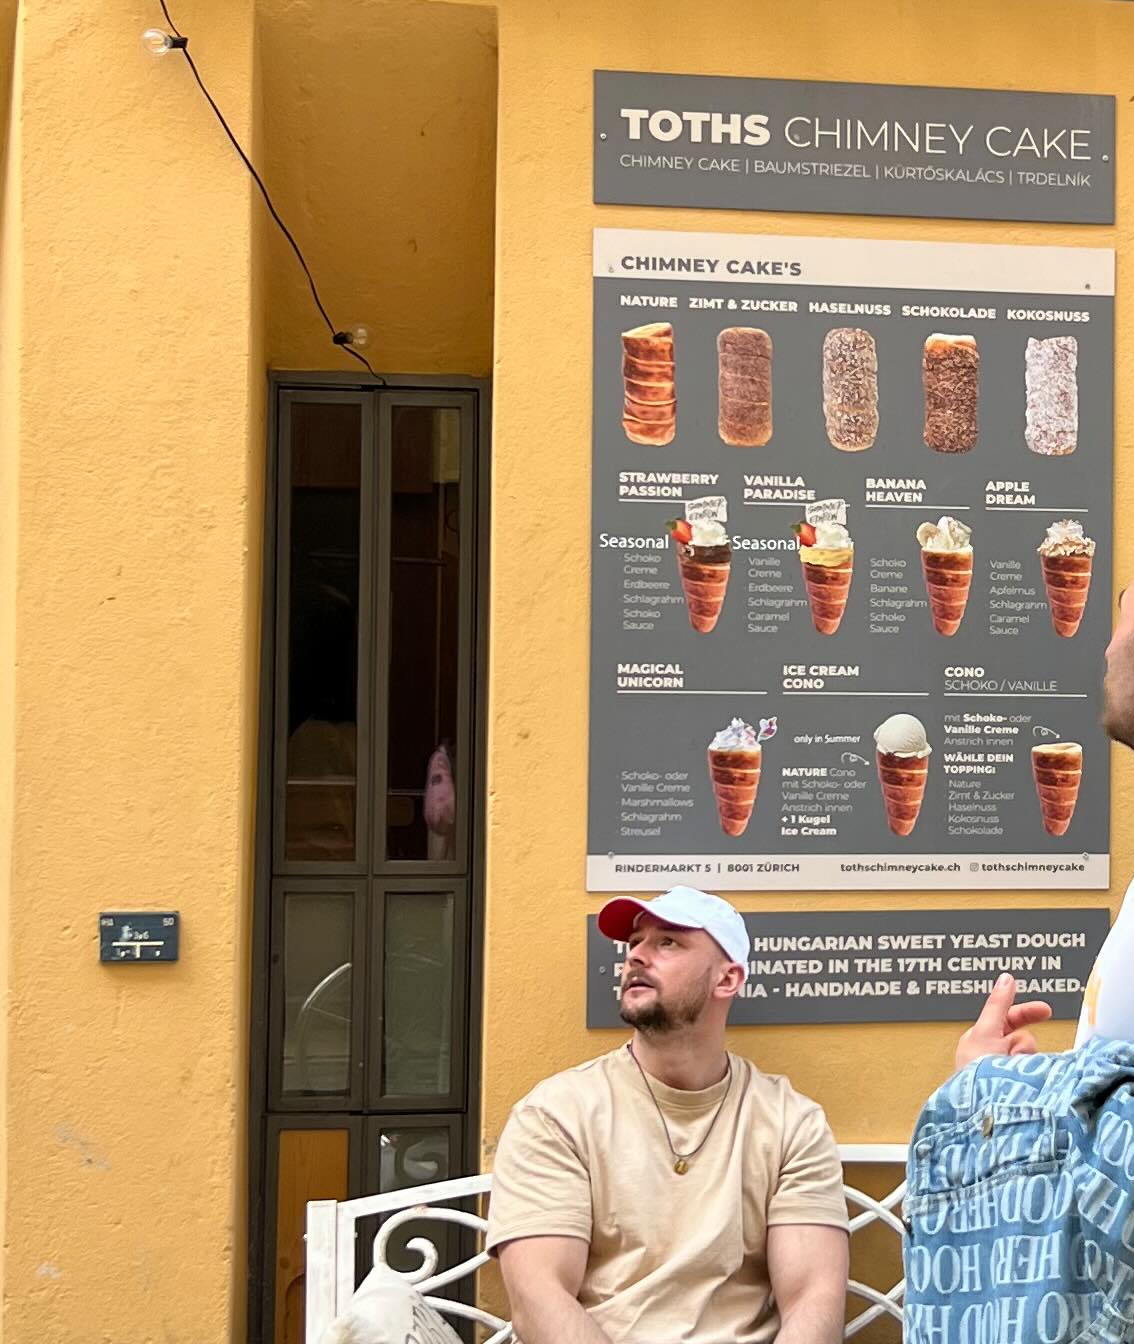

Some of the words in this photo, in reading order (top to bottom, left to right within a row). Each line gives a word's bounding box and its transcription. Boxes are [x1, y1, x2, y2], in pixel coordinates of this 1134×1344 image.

[620, 108, 771, 146] TOTHS
[784, 116, 974, 155] CHIMNEY
[986, 125, 1092, 160] CAKE
[619, 154, 694, 170] CHIMNEY
[698, 157, 741, 172] CAKE
[754, 160, 871, 178] BAUMSTRIEZEL
[1017, 170, 1092, 187] TRDELNÍK
[621, 255, 720, 274] CHIMNEY
[726, 259, 802, 276] CAKE'S
[620, 294, 678, 308] NATURE
[689, 297, 724, 310] ZIMT
[741, 299, 798, 313] ZUCKER
[809, 301, 891, 316] HASELNUSS
[902, 305, 996, 319] SCHOKOLADE
[1007, 308, 1090, 322] KOKOSNUSS
[619, 471, 719, 485] STRAWBERRY
[744, 474, 805, 487] VANILLA
[866, 477, 927, 490] BANANA
[619, 485, 683, 498] PASSION
[985, 480, 1030, 493] APPLE
[744, 488, 816, 501] PARADISE
[866, 491, 923, 503] HEAVEN
[985, 494, 1036, 505] DREAM
[599, 533, 669, 549] Seasonal
[732, 535, 801, 551] Seasonal
[617, 663, 684, 675] MAGICAL
[783, 664, 806, 677] ICE
[809, 665, 860, 677] CREAM
[944, 666, 985, 678] CONO
[617, 676, 684, 688] UNICORN
[783, 678, 825, 689] CONO
[944, 679, 998, 692] SCHOKO
[1006, 680, 1058, 692] VANILLE
[963, 712, 1008, 723] Schoko-
[944, 724, 981, 734] Vanille
[983, 725, 1019, 734] Creme
[793, 734, 814, 745] only
[824, 734, 861, 744] Summer
[944, 751, 985, 762] WÄHLE
[986, 753, 1014, 763] DEIN
[782, 767, 828, 777] NATURE
[798, 815, 831, 826] Kugel
[781, 826, 798, 836] Ice
[800, 826, 837, 836] Cream
[615, 863, 702, 873] RINDERMARKT
[704, 863, 712, 873] 5
[727, 863, 754, 873] 8001
[756, 861, 800, 873] ZÜRICH
[840, 862, 961, 874] tothschimneycake.ch
[981, 862, 1085, 874] tothschimneycake
[754, 935, 873, 952] HUNGARIAN
[878, 934, 946, 950] SWEET
[949, 933, 1012, 949] YEAST
[1016, 932, 1086, 948] DOUGH
[828, 958, 848, 974] IN
[854, 957, 893, 973] THE
[897, 957, 942, 972] 17TH
[947, 955, 1036, 971] CENTURY
[1041, 955, 1061, 971] IN
[785, 981, 902, 998] HANDMADE
[906, 981, 921, 996] &
